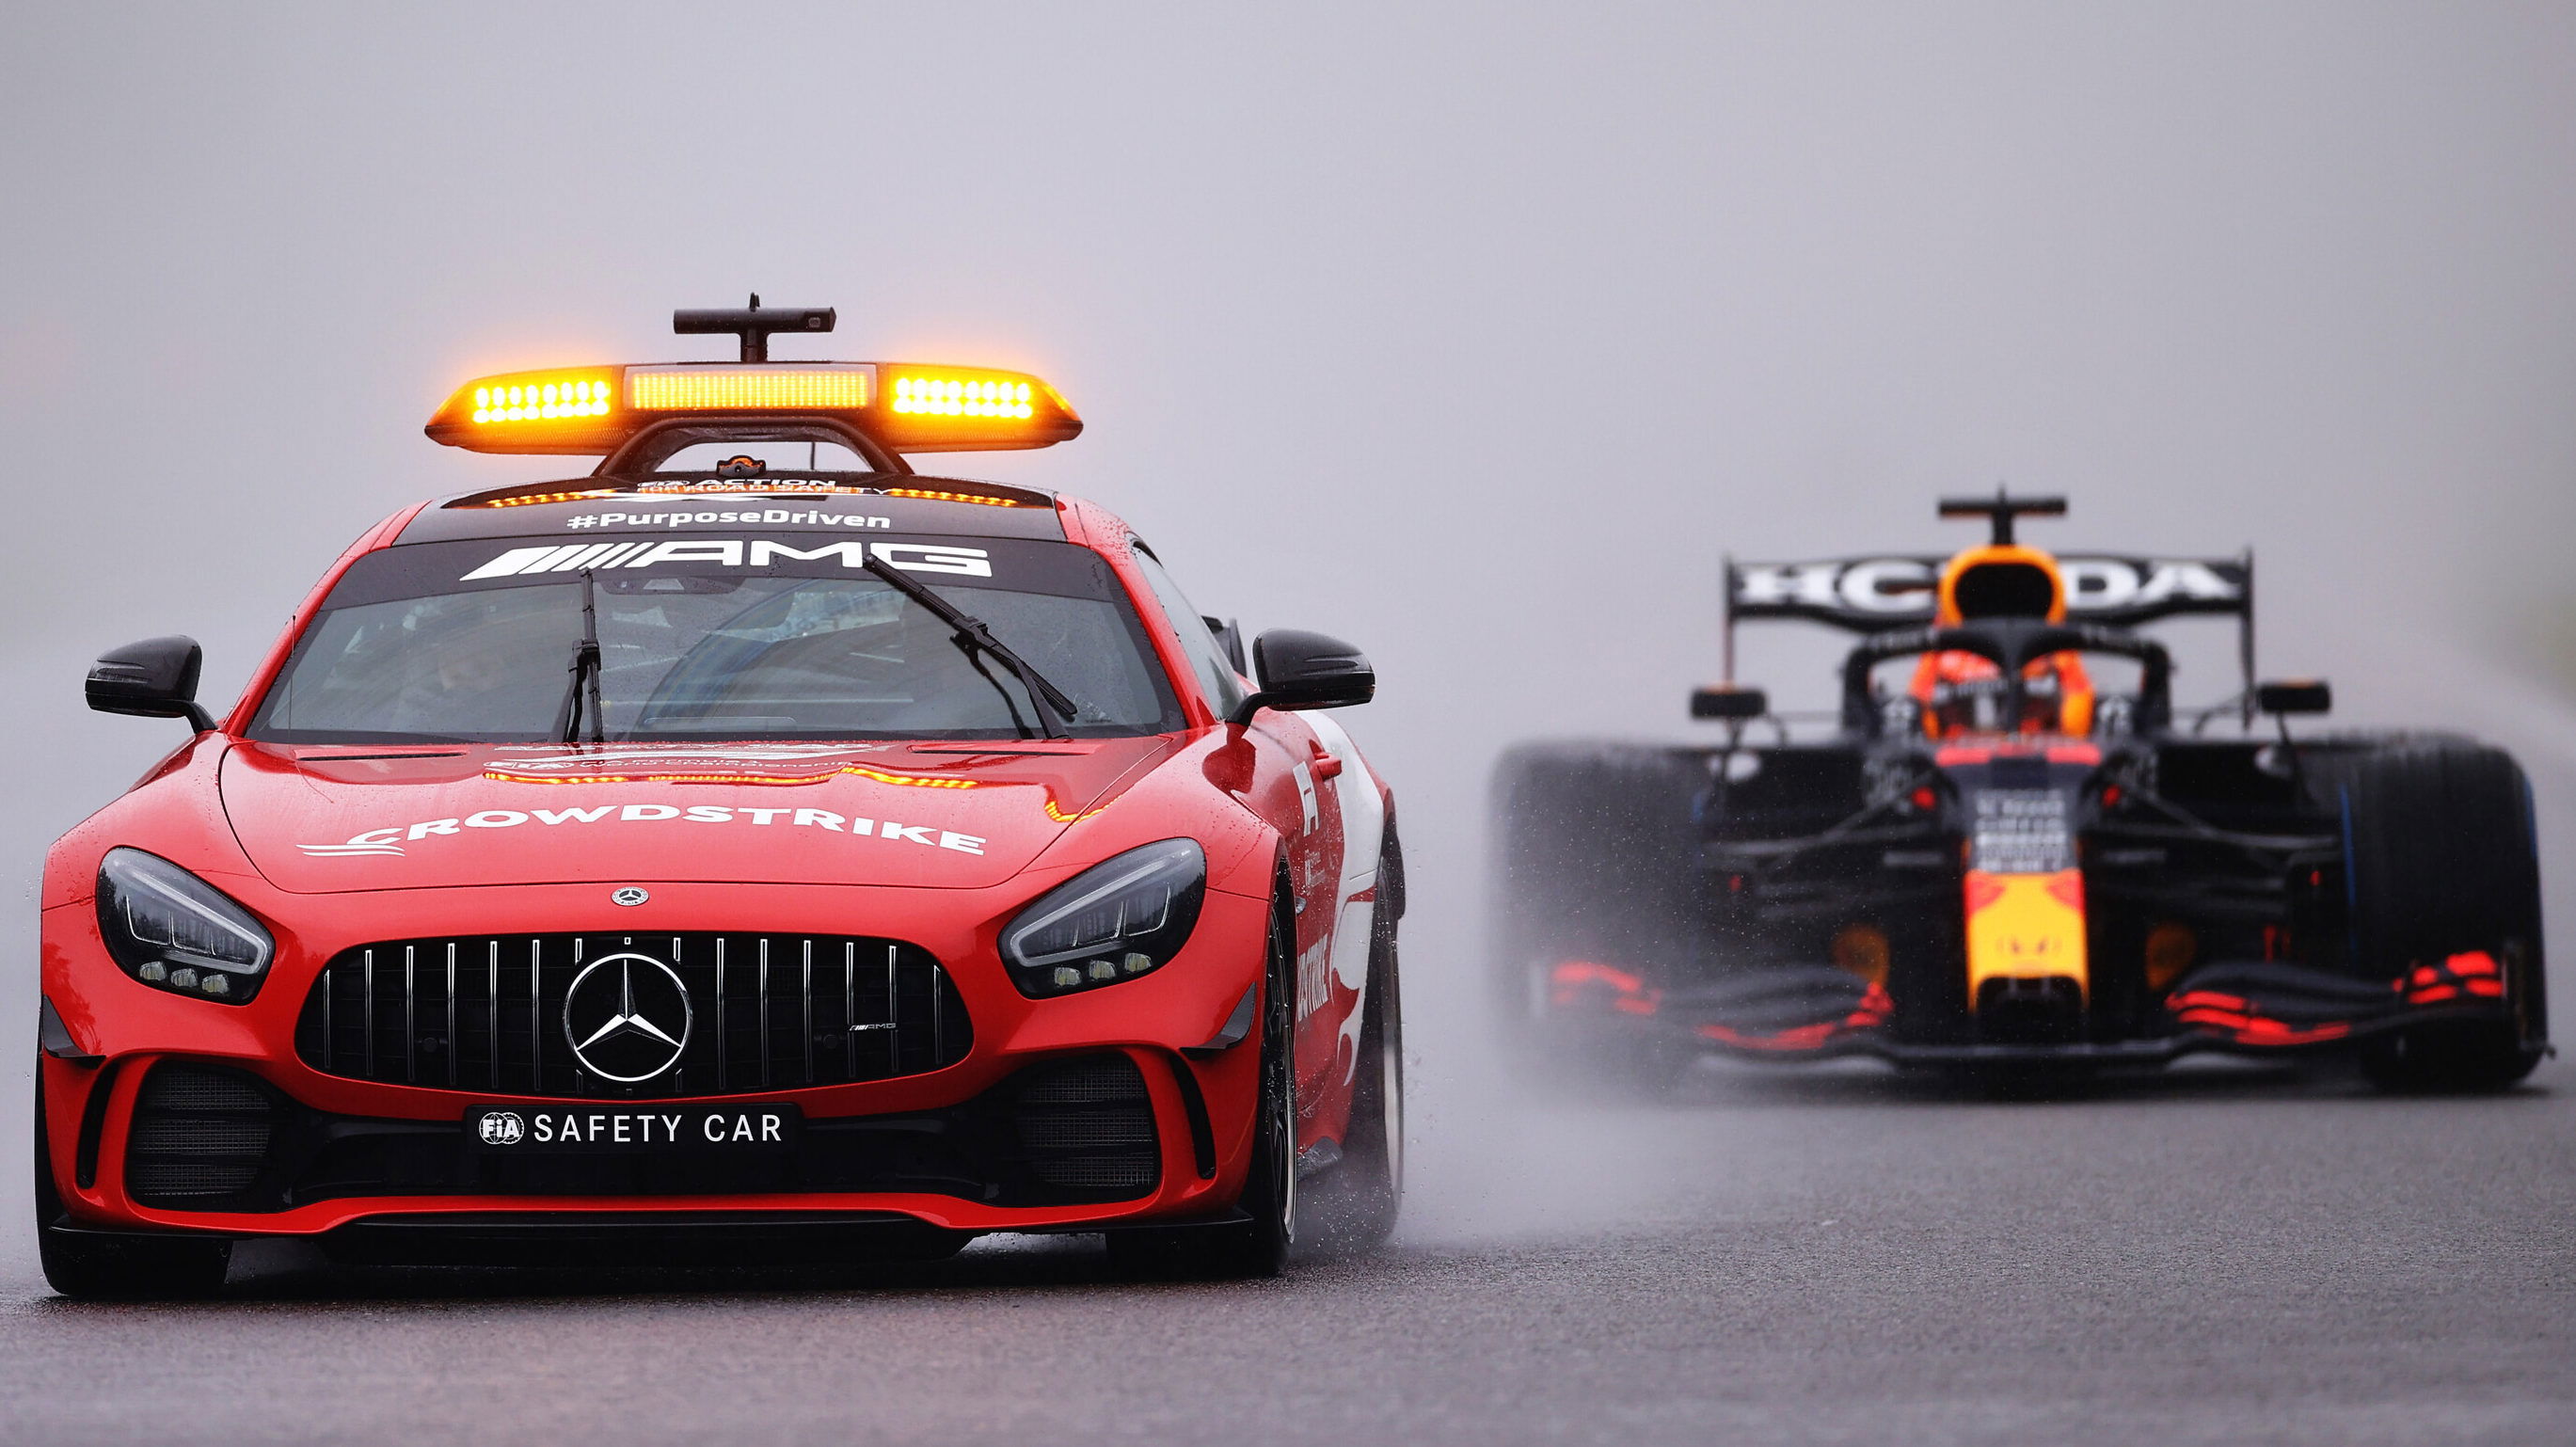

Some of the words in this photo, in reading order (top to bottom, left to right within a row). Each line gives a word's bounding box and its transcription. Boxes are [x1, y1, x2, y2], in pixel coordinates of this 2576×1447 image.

[566, 508, 891, 530] #PurposeDriven
[1741, 562, 2235, 612] HODA
[346, 803, 987, 857] CROWDSTRIKE
[533, 1113, 682, 1142] SAFETY
[705, 1114, 782, 1142] CAR
